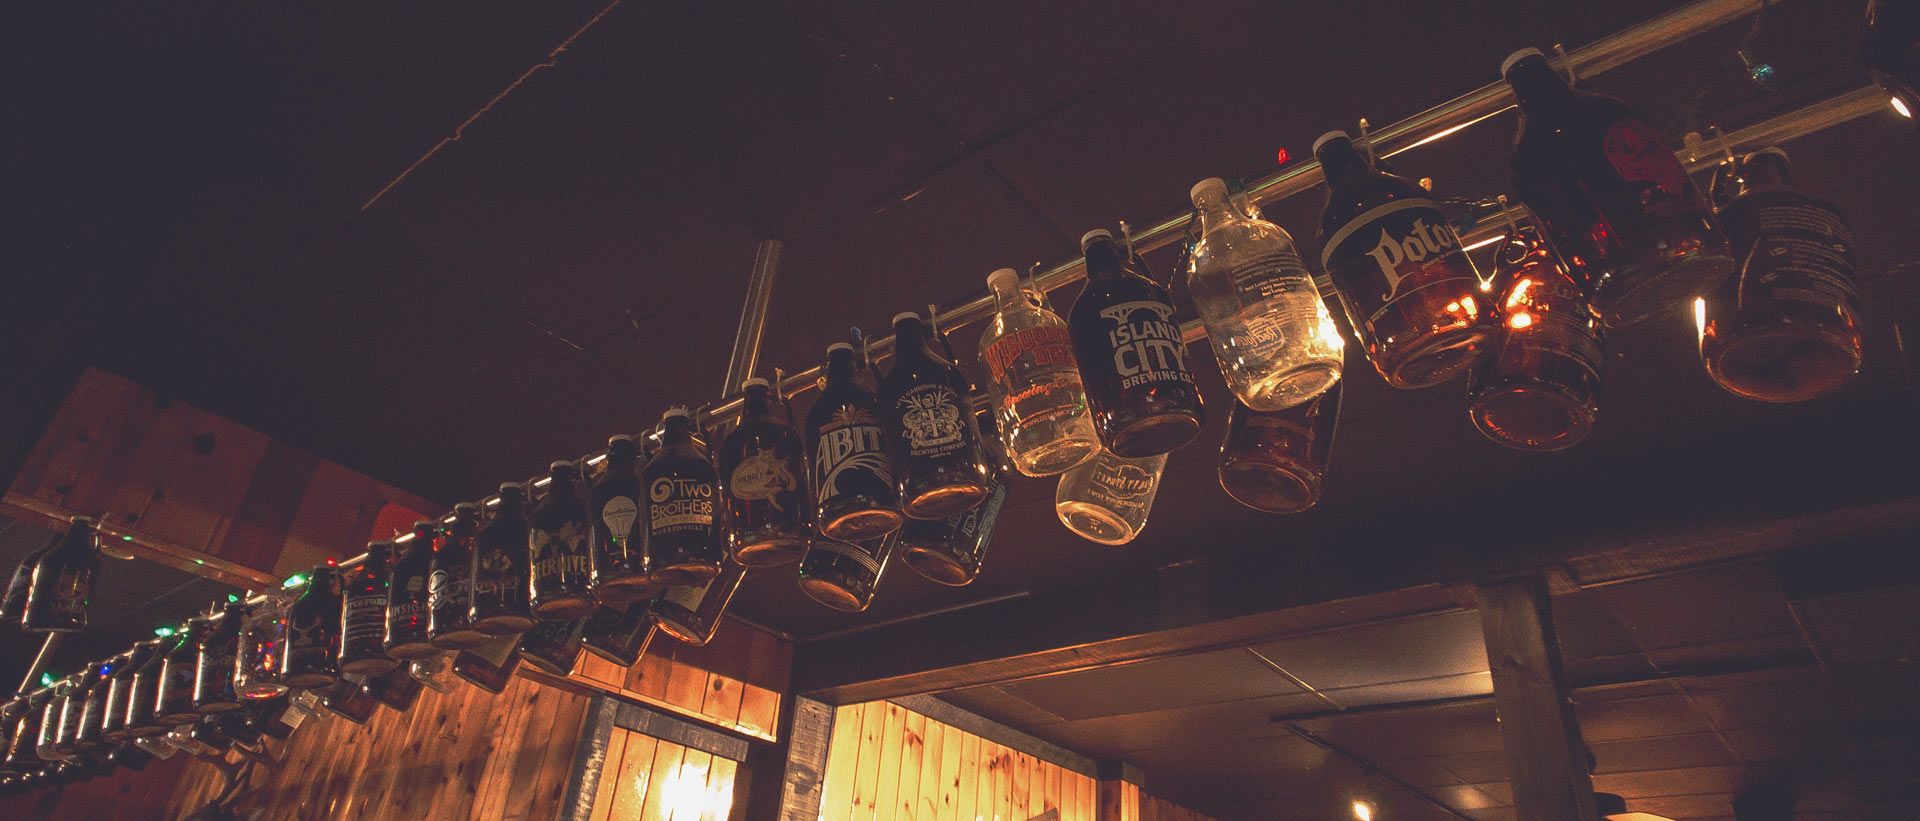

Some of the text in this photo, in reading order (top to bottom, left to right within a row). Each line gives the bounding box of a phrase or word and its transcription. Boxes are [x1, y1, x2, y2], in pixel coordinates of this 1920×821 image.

[1109, 320, 1181, 348] ISLAND
[1114, 339, 1187, 376] CITY
[1122, 370, 1177, 390] BREWING
[939, 440, 967, 453] COMPANY
[816, 425, 884, 499] ABIT
[673, 479, 712, 498] TWO
[651, 499, 713, 521] BROTHERS
